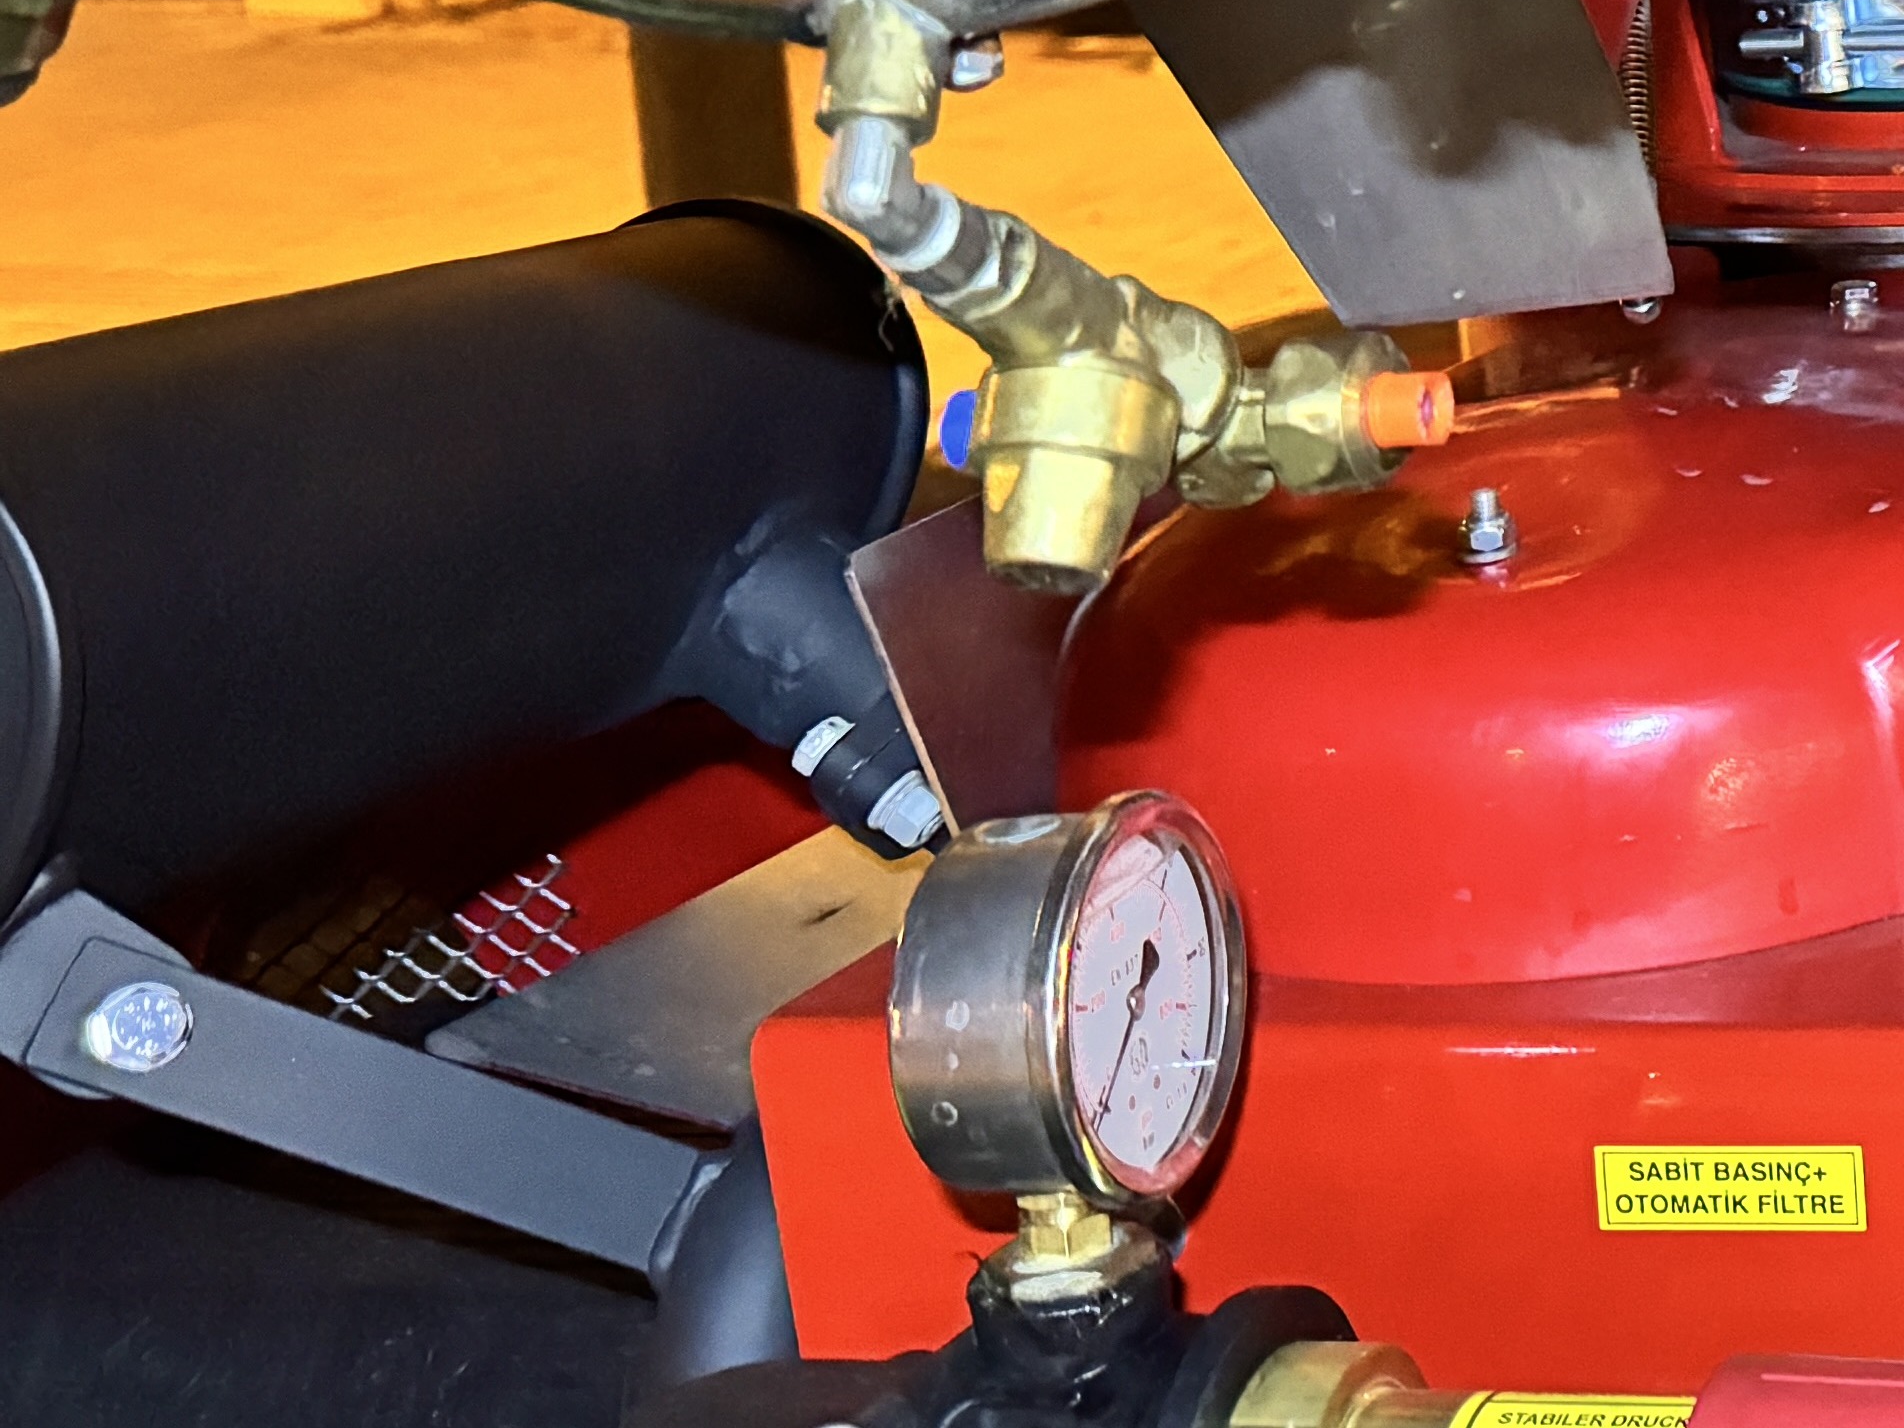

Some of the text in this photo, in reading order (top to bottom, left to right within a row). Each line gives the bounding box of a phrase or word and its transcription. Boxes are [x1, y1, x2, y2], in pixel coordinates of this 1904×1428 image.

[1629, 1157, 1827, 1186] SABİT BASINÇ+
[1615, 1189, 1845, 1214] OTOMATİK FİLTRE
[1498, 1411, 1606, 1427] STABILER
